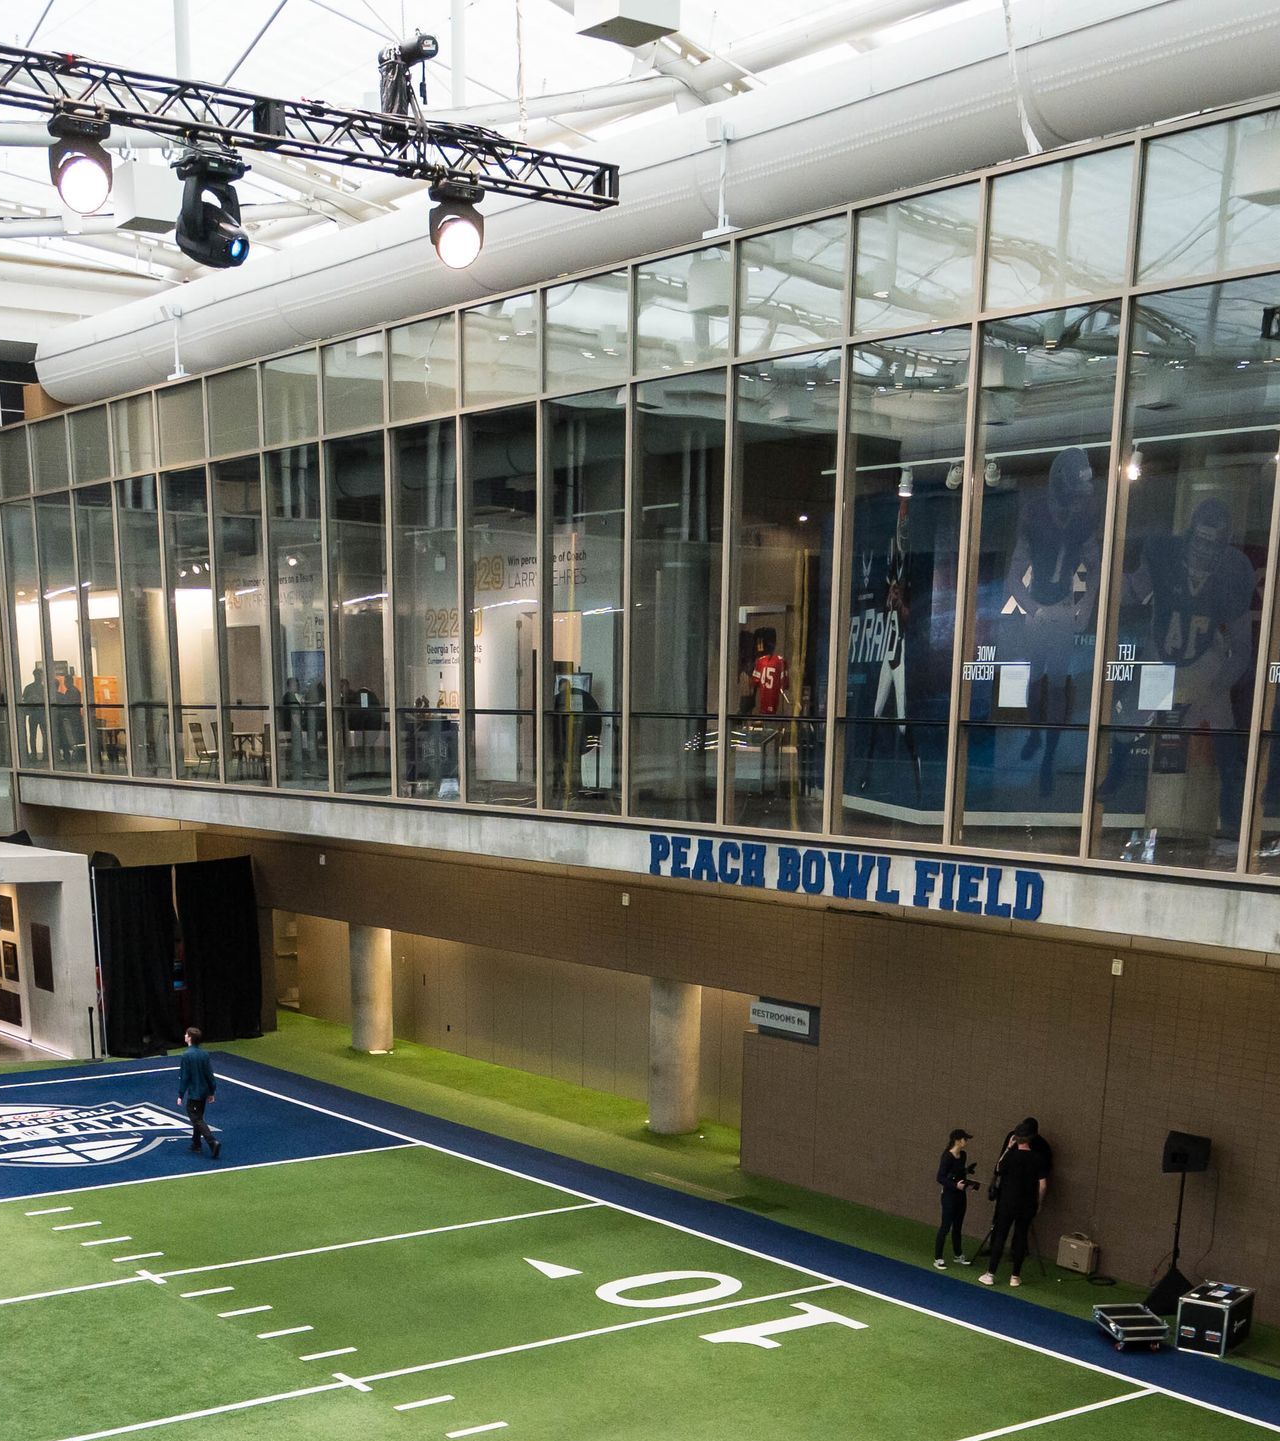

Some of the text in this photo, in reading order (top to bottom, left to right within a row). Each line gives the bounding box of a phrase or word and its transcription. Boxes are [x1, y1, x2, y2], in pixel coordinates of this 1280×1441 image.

[554, 568, 587, 587] EHRES
[649, 834, 1045, 922] PEACH BOWL FIELD
[751, 1008, 796, 1025] RESTROOMS
[7, 1108, 115, 1128] FOOTBALL
[48, 1111, 175, 1134] FAME
